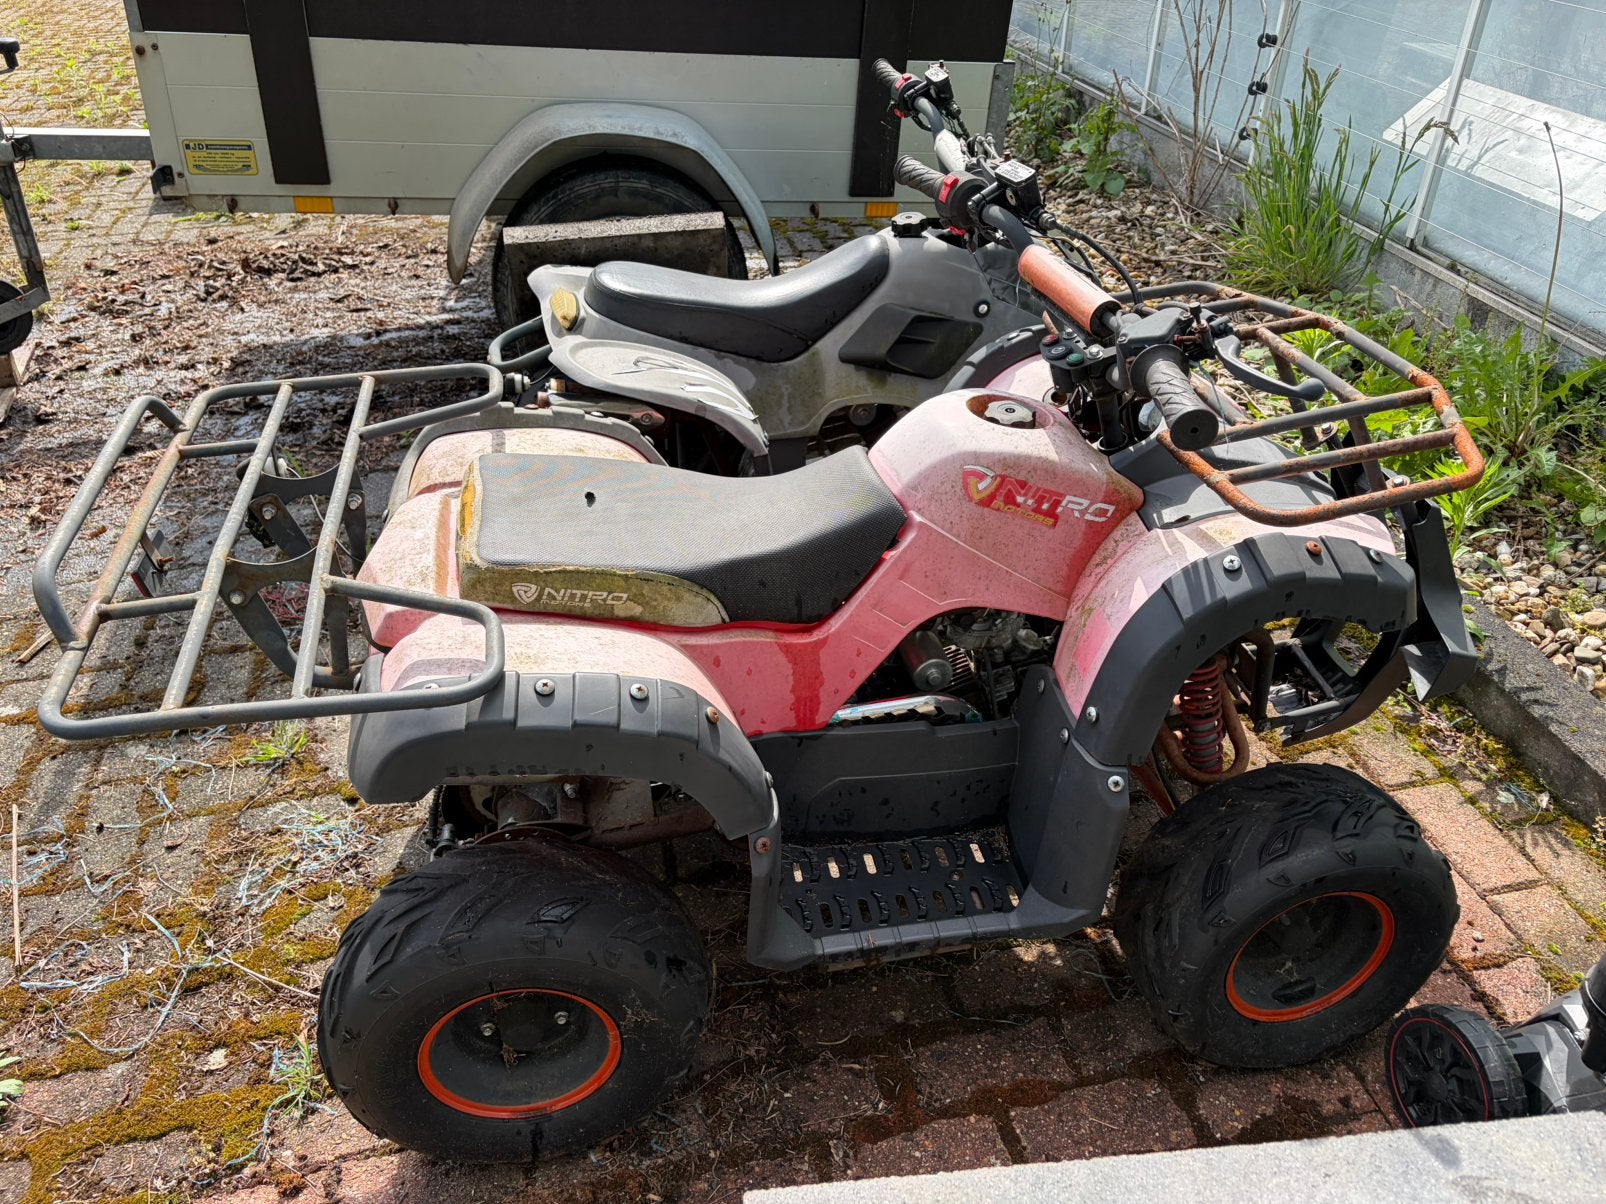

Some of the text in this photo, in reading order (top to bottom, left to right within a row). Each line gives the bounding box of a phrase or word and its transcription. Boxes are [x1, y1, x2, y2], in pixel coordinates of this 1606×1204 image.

[192, 142, 204, 150] JD
[996, 477, 1116, 523] NITRO
[542, 587, 629, 605] NITRO
